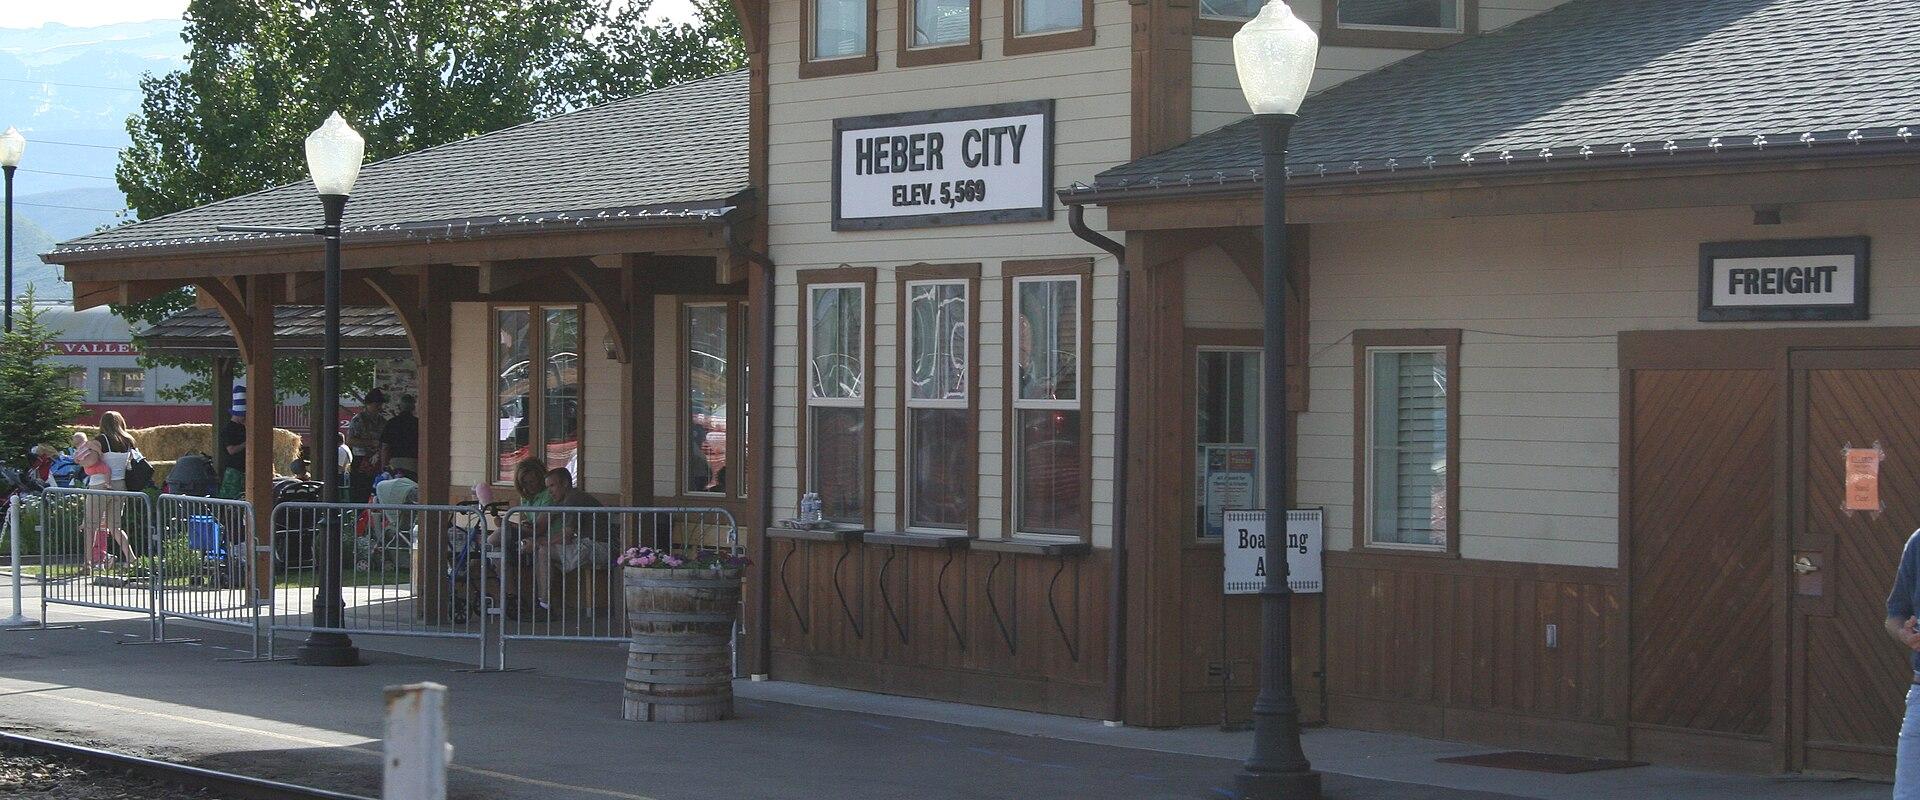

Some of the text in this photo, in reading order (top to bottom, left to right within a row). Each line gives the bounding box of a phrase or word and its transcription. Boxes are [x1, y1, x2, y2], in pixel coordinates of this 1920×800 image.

[855, 124, 1027, 175] HEBER CITY
[892, 179, 986, 209] ELEV. 5,569
[1728, 265, 1838, 295] FREIGHT
[1238, 528, 1309, 554] Boang
